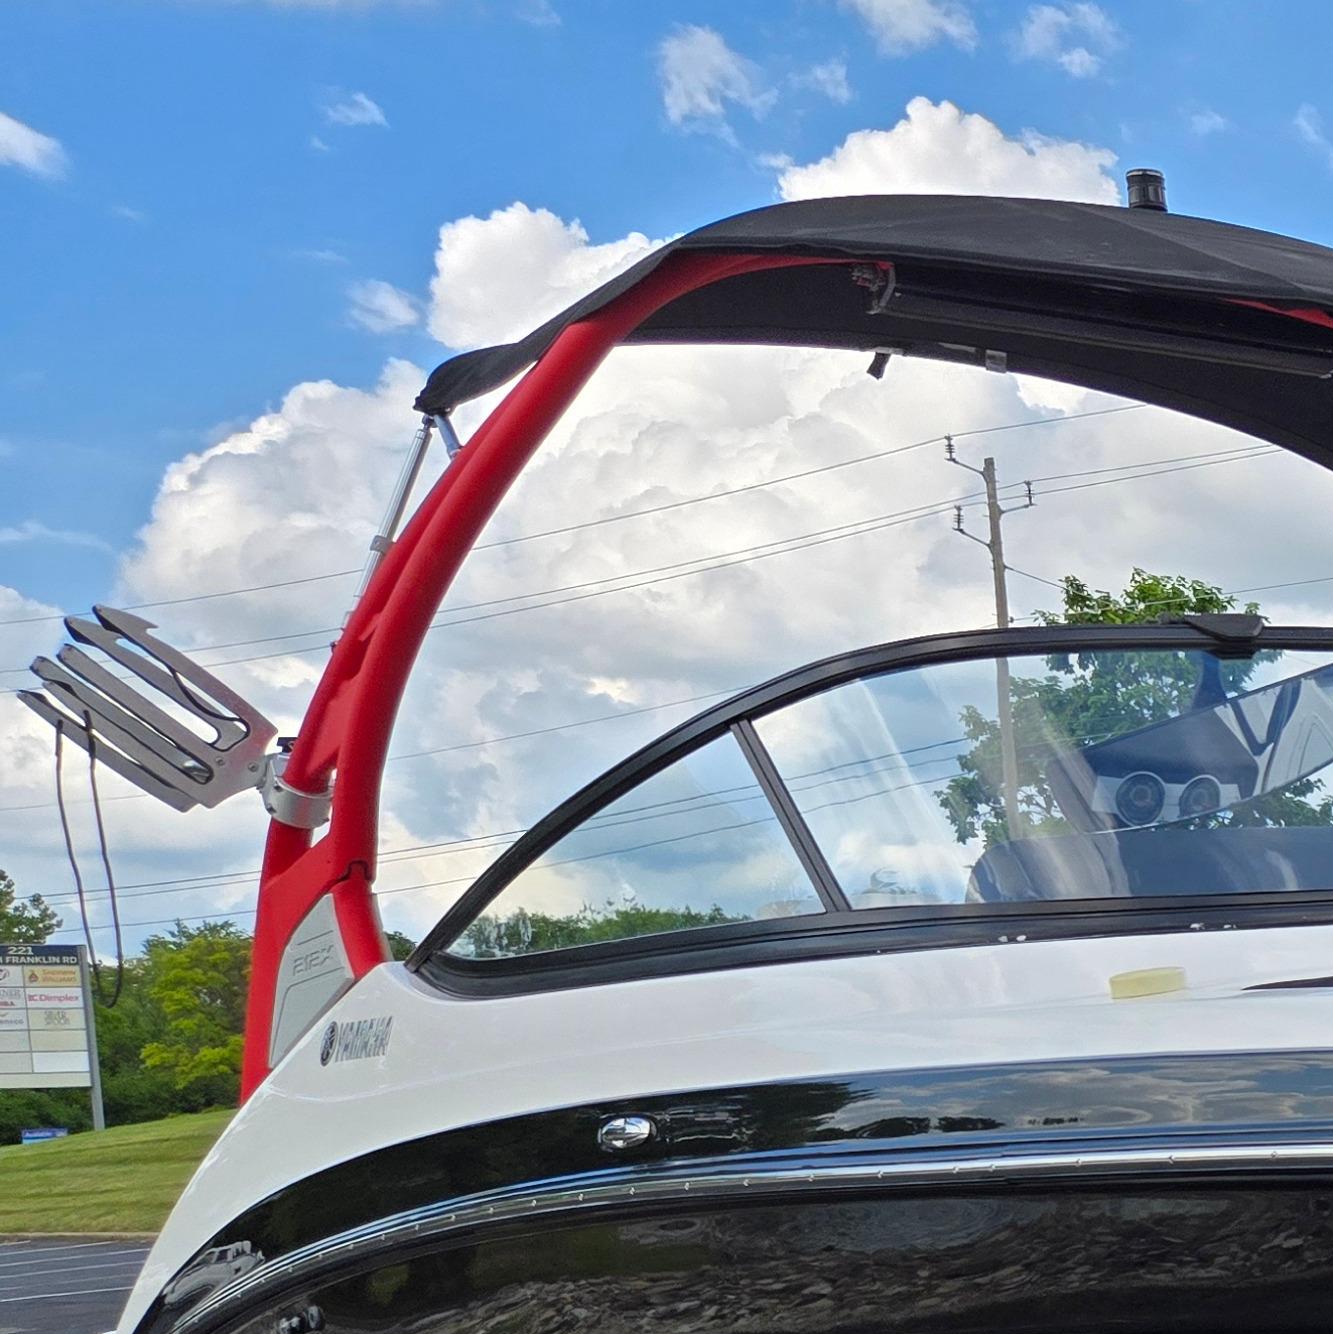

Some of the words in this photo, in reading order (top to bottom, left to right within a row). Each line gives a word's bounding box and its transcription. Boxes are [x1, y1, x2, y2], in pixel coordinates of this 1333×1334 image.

[8, 947, 34, 955] 221
[6, 956, 60, 964] FRANKLIN
[63, 956, 77, 964] RD
